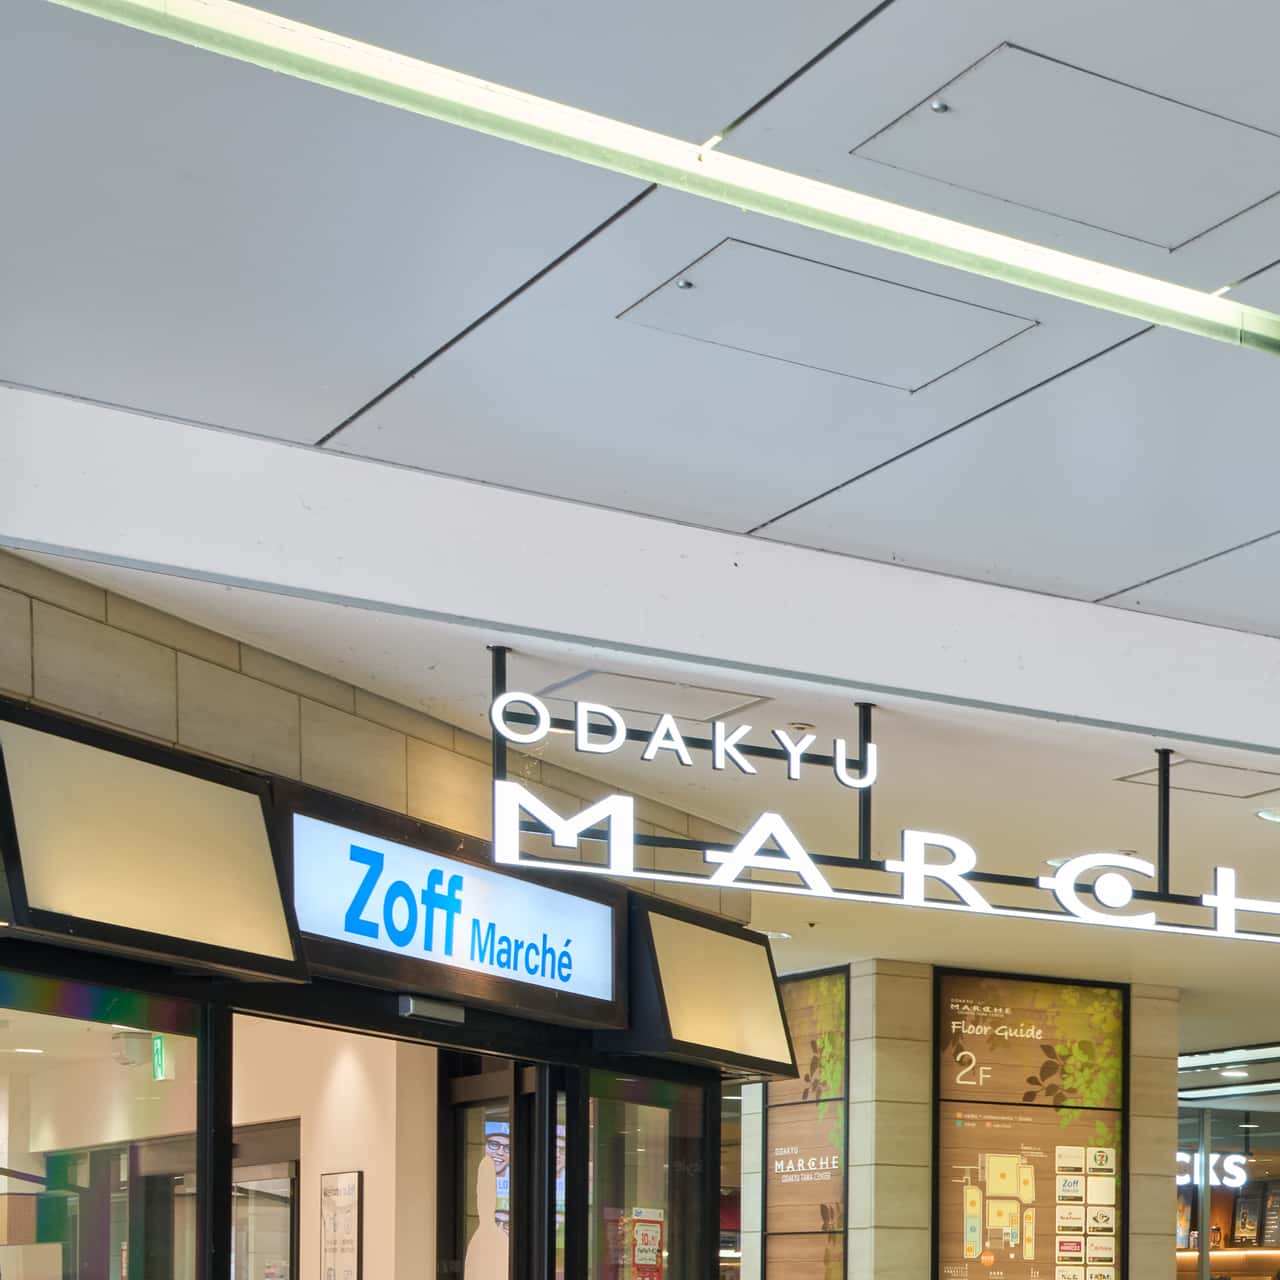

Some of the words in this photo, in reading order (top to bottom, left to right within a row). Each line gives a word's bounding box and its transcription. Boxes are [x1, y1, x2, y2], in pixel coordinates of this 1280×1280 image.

[490, 691, 878, 789] ODAKYU
[344, 844, 464, 957] Zoff
[469, 917, 573, 983] Marché
[951, 1020, 992, 1034] Floor
[995, 1023, 1043, 1040] Guide
[956, 1051, 992, 1086] 2F
[775, 1156, 839, 1174] MARCHE
[1062, 1179, 1080, 1188] Zoff
